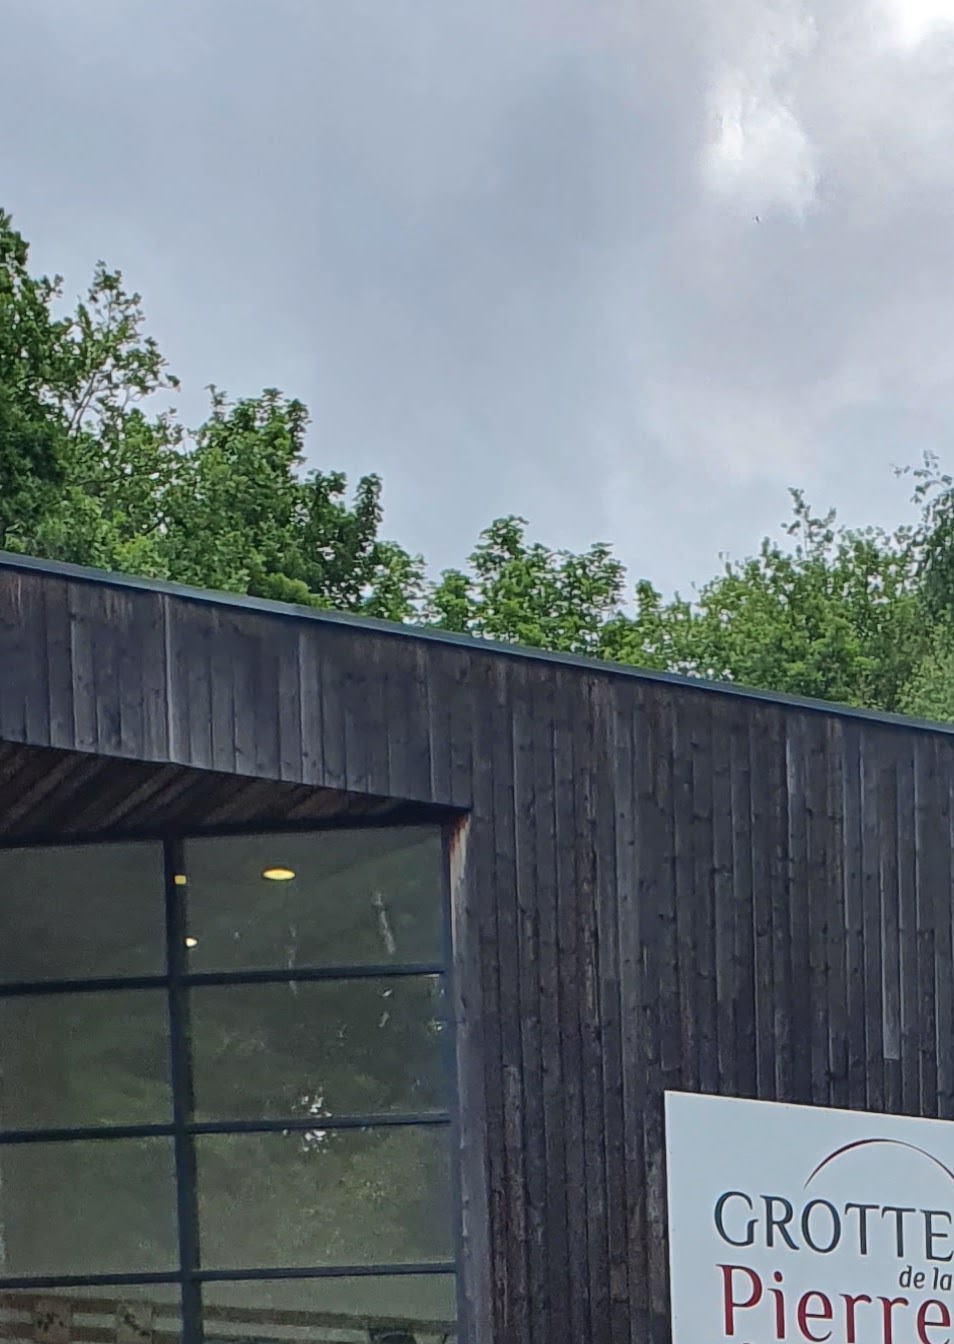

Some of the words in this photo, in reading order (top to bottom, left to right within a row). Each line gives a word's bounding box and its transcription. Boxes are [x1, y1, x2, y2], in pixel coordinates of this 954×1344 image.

[714, 1191, 954, 1262] GROTTE
[899, 1265, 925, 1290] de
[932, 1267, 953, 1291] la
